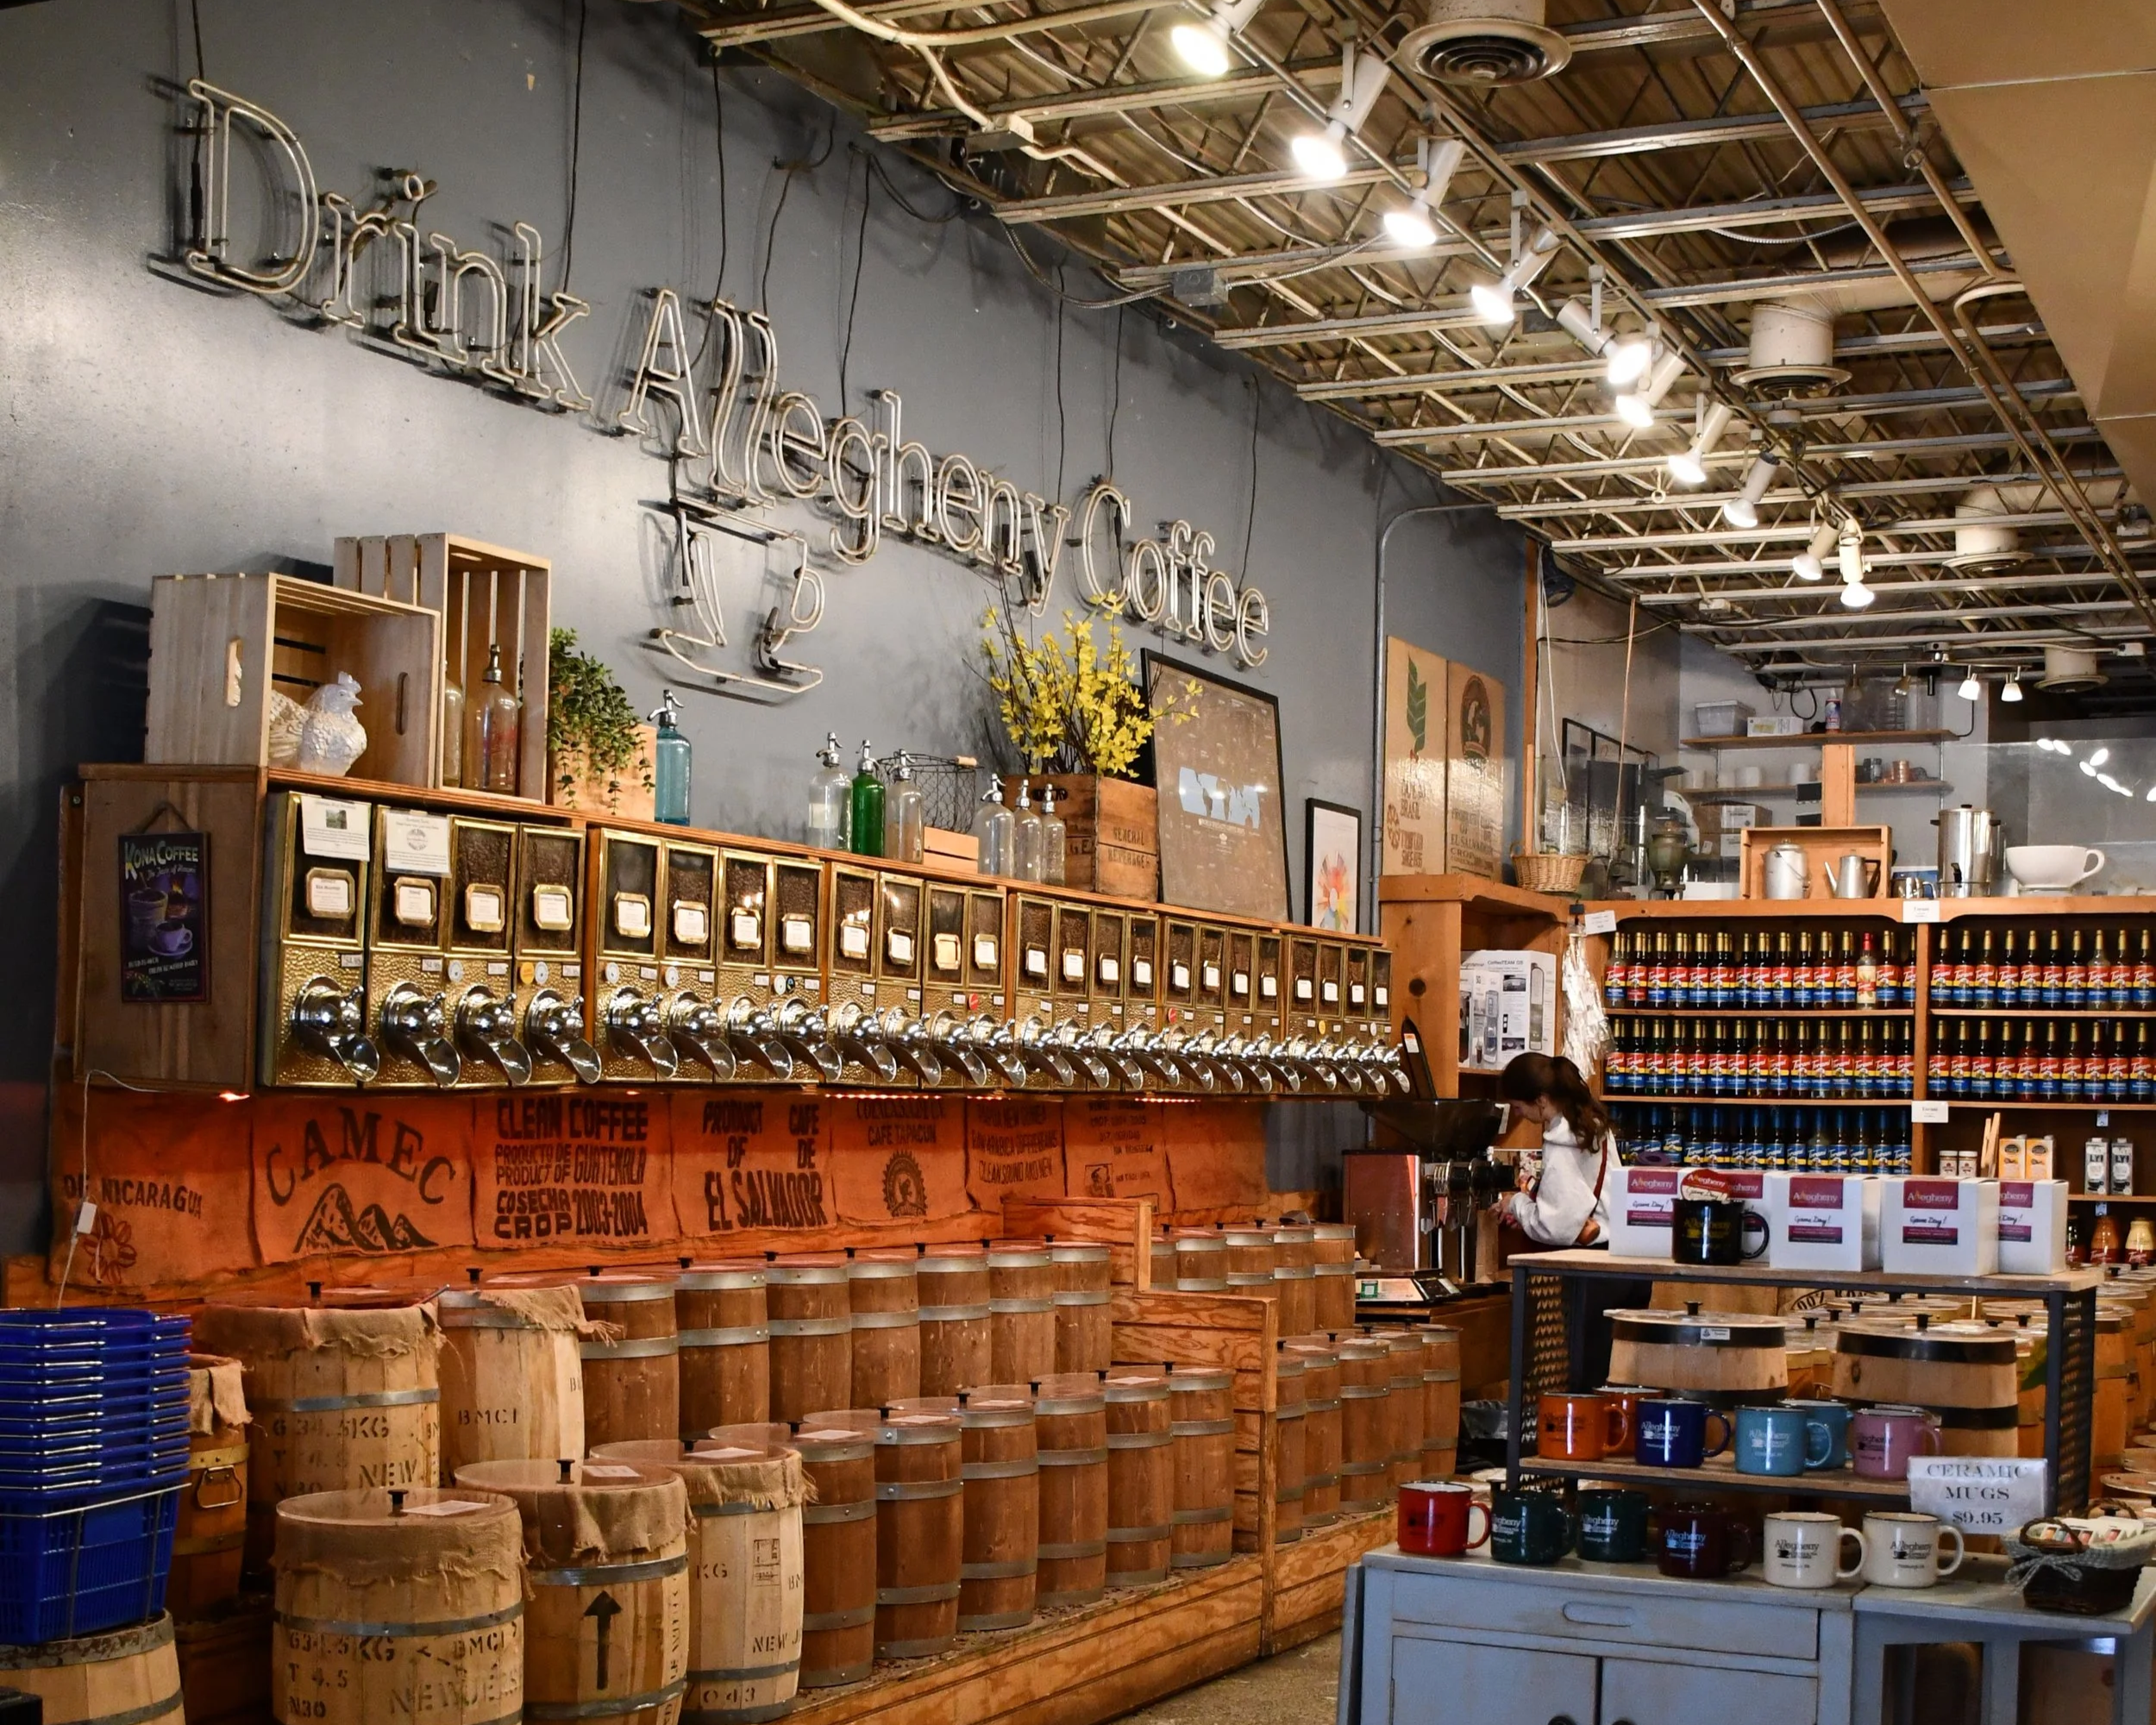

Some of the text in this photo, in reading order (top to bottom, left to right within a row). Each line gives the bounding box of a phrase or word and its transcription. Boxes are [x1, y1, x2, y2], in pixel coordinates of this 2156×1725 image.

[186, 78, 1270, 668] Drink Allegheny Coffee
[124, 840, 199, 881] KONA COFFEE
[498, 1097, 648, 1141] CLEAN COFFEE
[702, 1101, 764, 1135] PRODUCT
[788, 1104, 820, 1136] CAFE
[266, 1105, 456, 1207] CAMEC
[495, 1144, 572, 1165] PRODUCTO DE
[573, 1145, 647, 1186] GUATEMALA
[727, 1136, 748, 1169] OF
[797, 1138, 817, 1170] DE
[496, 1164, 571, 1186] PRODUCT OF
[102, 1176, 204, 1220] NICARAGUA
[498, 1189, 570, 1214] COSECHA
[705, 1170, 828, 1232] EL SALVADOR
[494, 1212, 572, 1239] CROP
[359, 1458, 417, 1489] NEW
[1927, 1464, 2027, 1478] CERAMIC
[1945, 1486, 2009, 1500] MUGS
[1952, 1510, 2003, 1525] $9.95
[697, 1563, 728, 1580] KG
[752, 1633, 787, 1653] NEW
